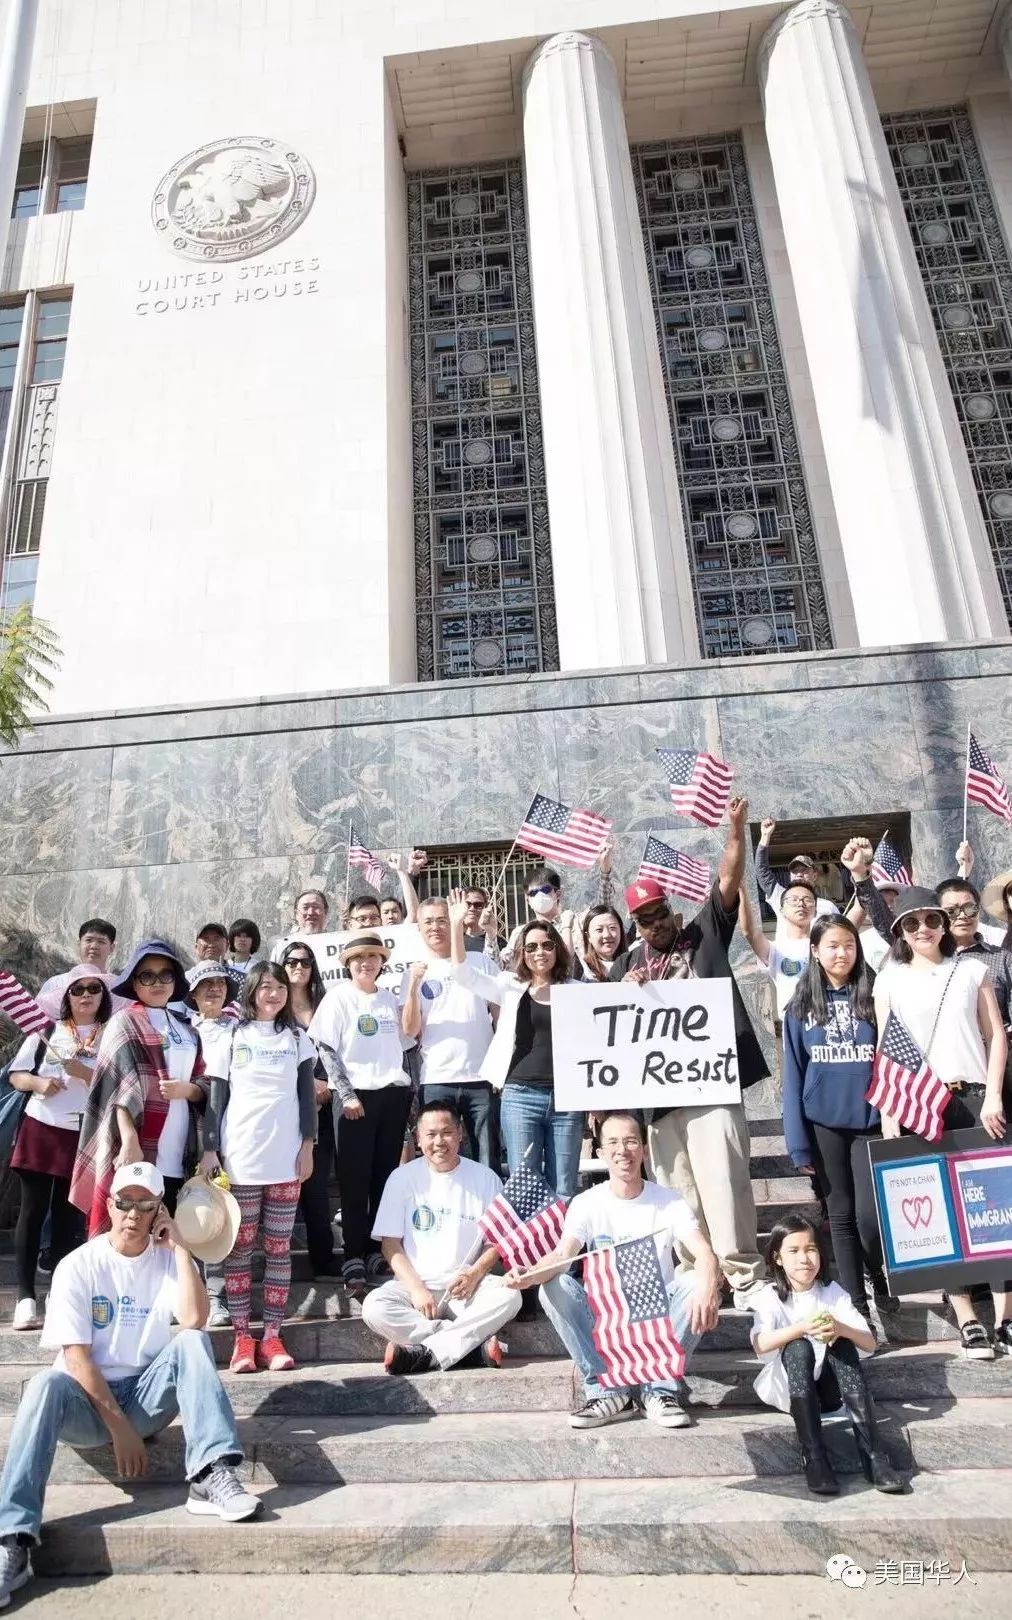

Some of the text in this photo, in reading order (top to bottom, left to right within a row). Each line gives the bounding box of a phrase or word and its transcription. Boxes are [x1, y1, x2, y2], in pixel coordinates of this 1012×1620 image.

[138, 257, 320, 293] UNITED STATES
[135, 280, 320, 316] COURT HOUSE
[593, 1003, 710, 1047] Time
[641, 1048, 737, 1086] Resist
[811, 1044, 874, 1063] BULLDOGS
[917, 1175, 936, 1185] CHAIN
[963, 1186, 986, 1203] HERE
[908, 1237, 931, 1249] CALLED
[932, 1235, 948, 1247] LOVE
